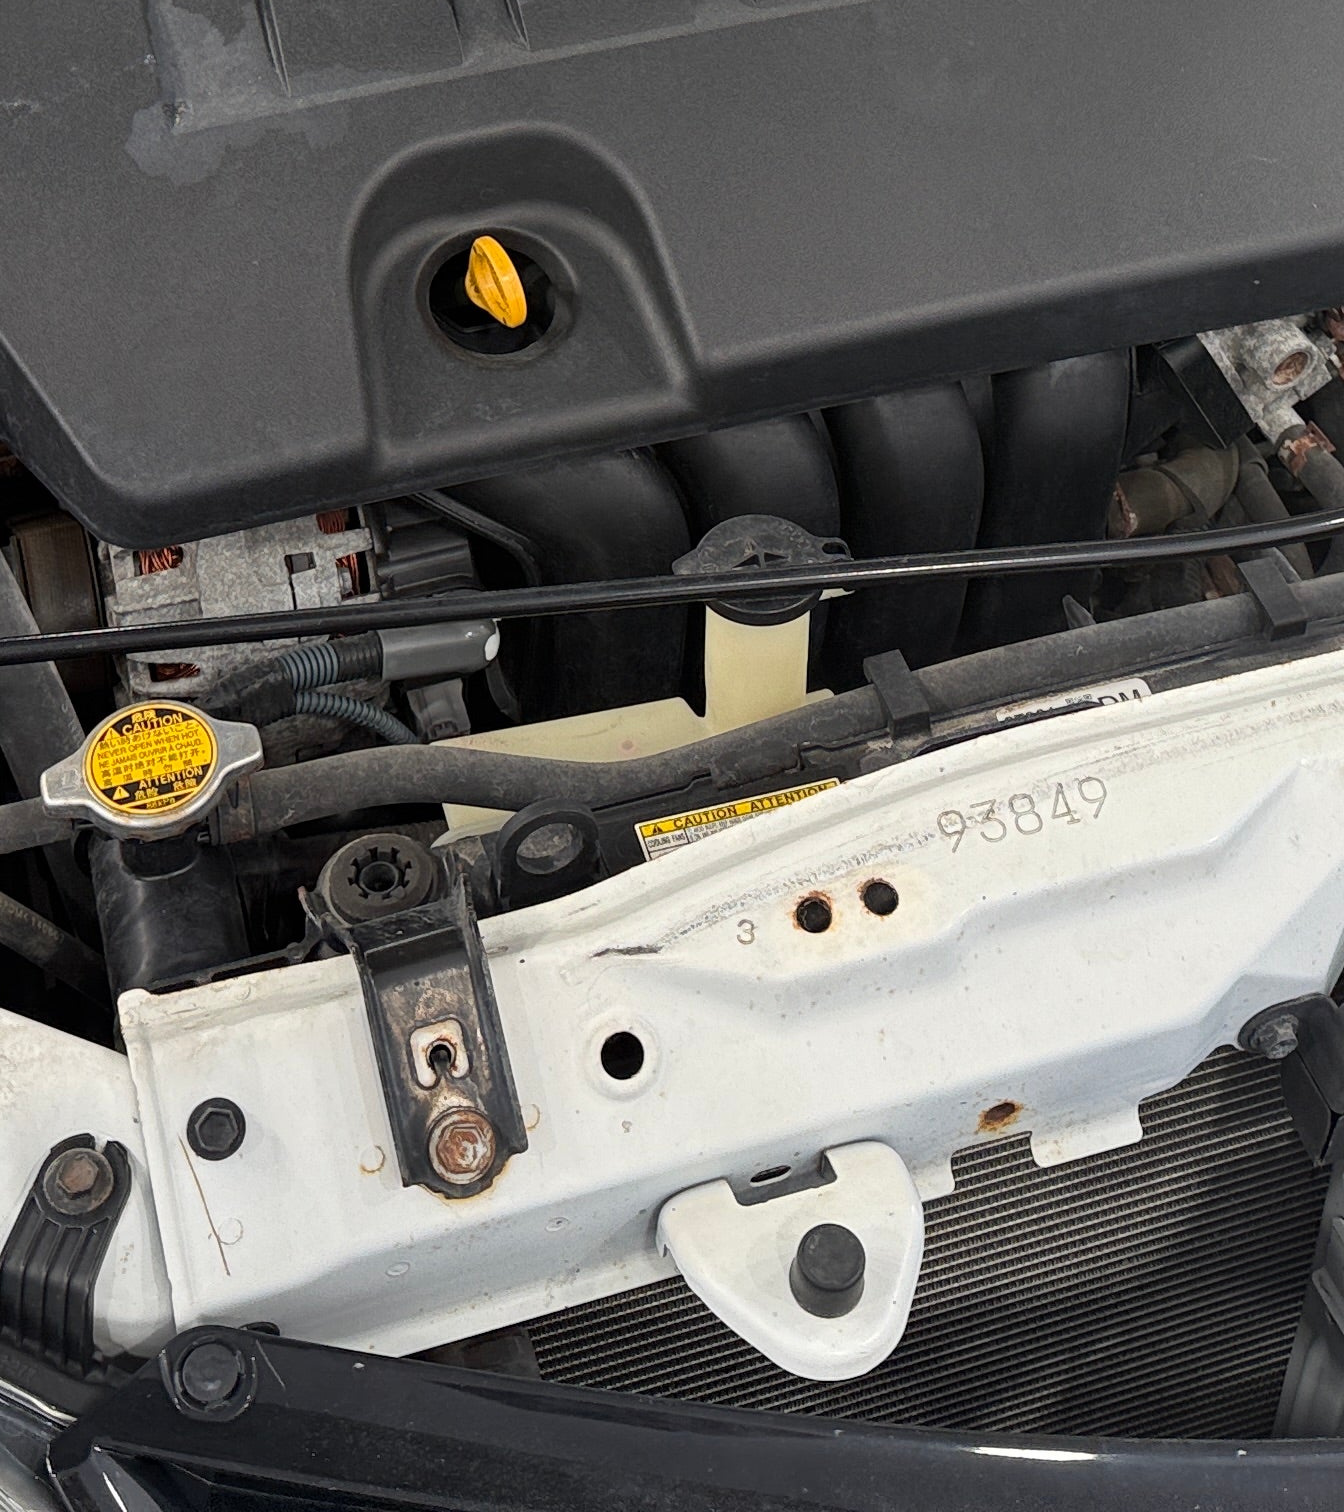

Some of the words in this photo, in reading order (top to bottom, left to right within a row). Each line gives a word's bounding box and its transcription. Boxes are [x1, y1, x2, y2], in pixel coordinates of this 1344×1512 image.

[122, 712, 183, 735] CAUTION
[97, 745, 127, 761] NEVER
[128, 740, 153, 753] OPEN
[154, 734, 180, 747] WHEN
[181, 728, 199, 741] HOT
[98, 759, 110, 769] NE
[111, 752, 138, 767] JAMAIS
[138, 745, 168, 760] OUVRIR
[138, 766, 204, 789] ATTENTION
[673, 804, 737, 829] CAUTION
[750, 784, 828, 812] ATTENTION
[936, 775, 1109, 855] 93849
[736, 918, 756, 946] 3
